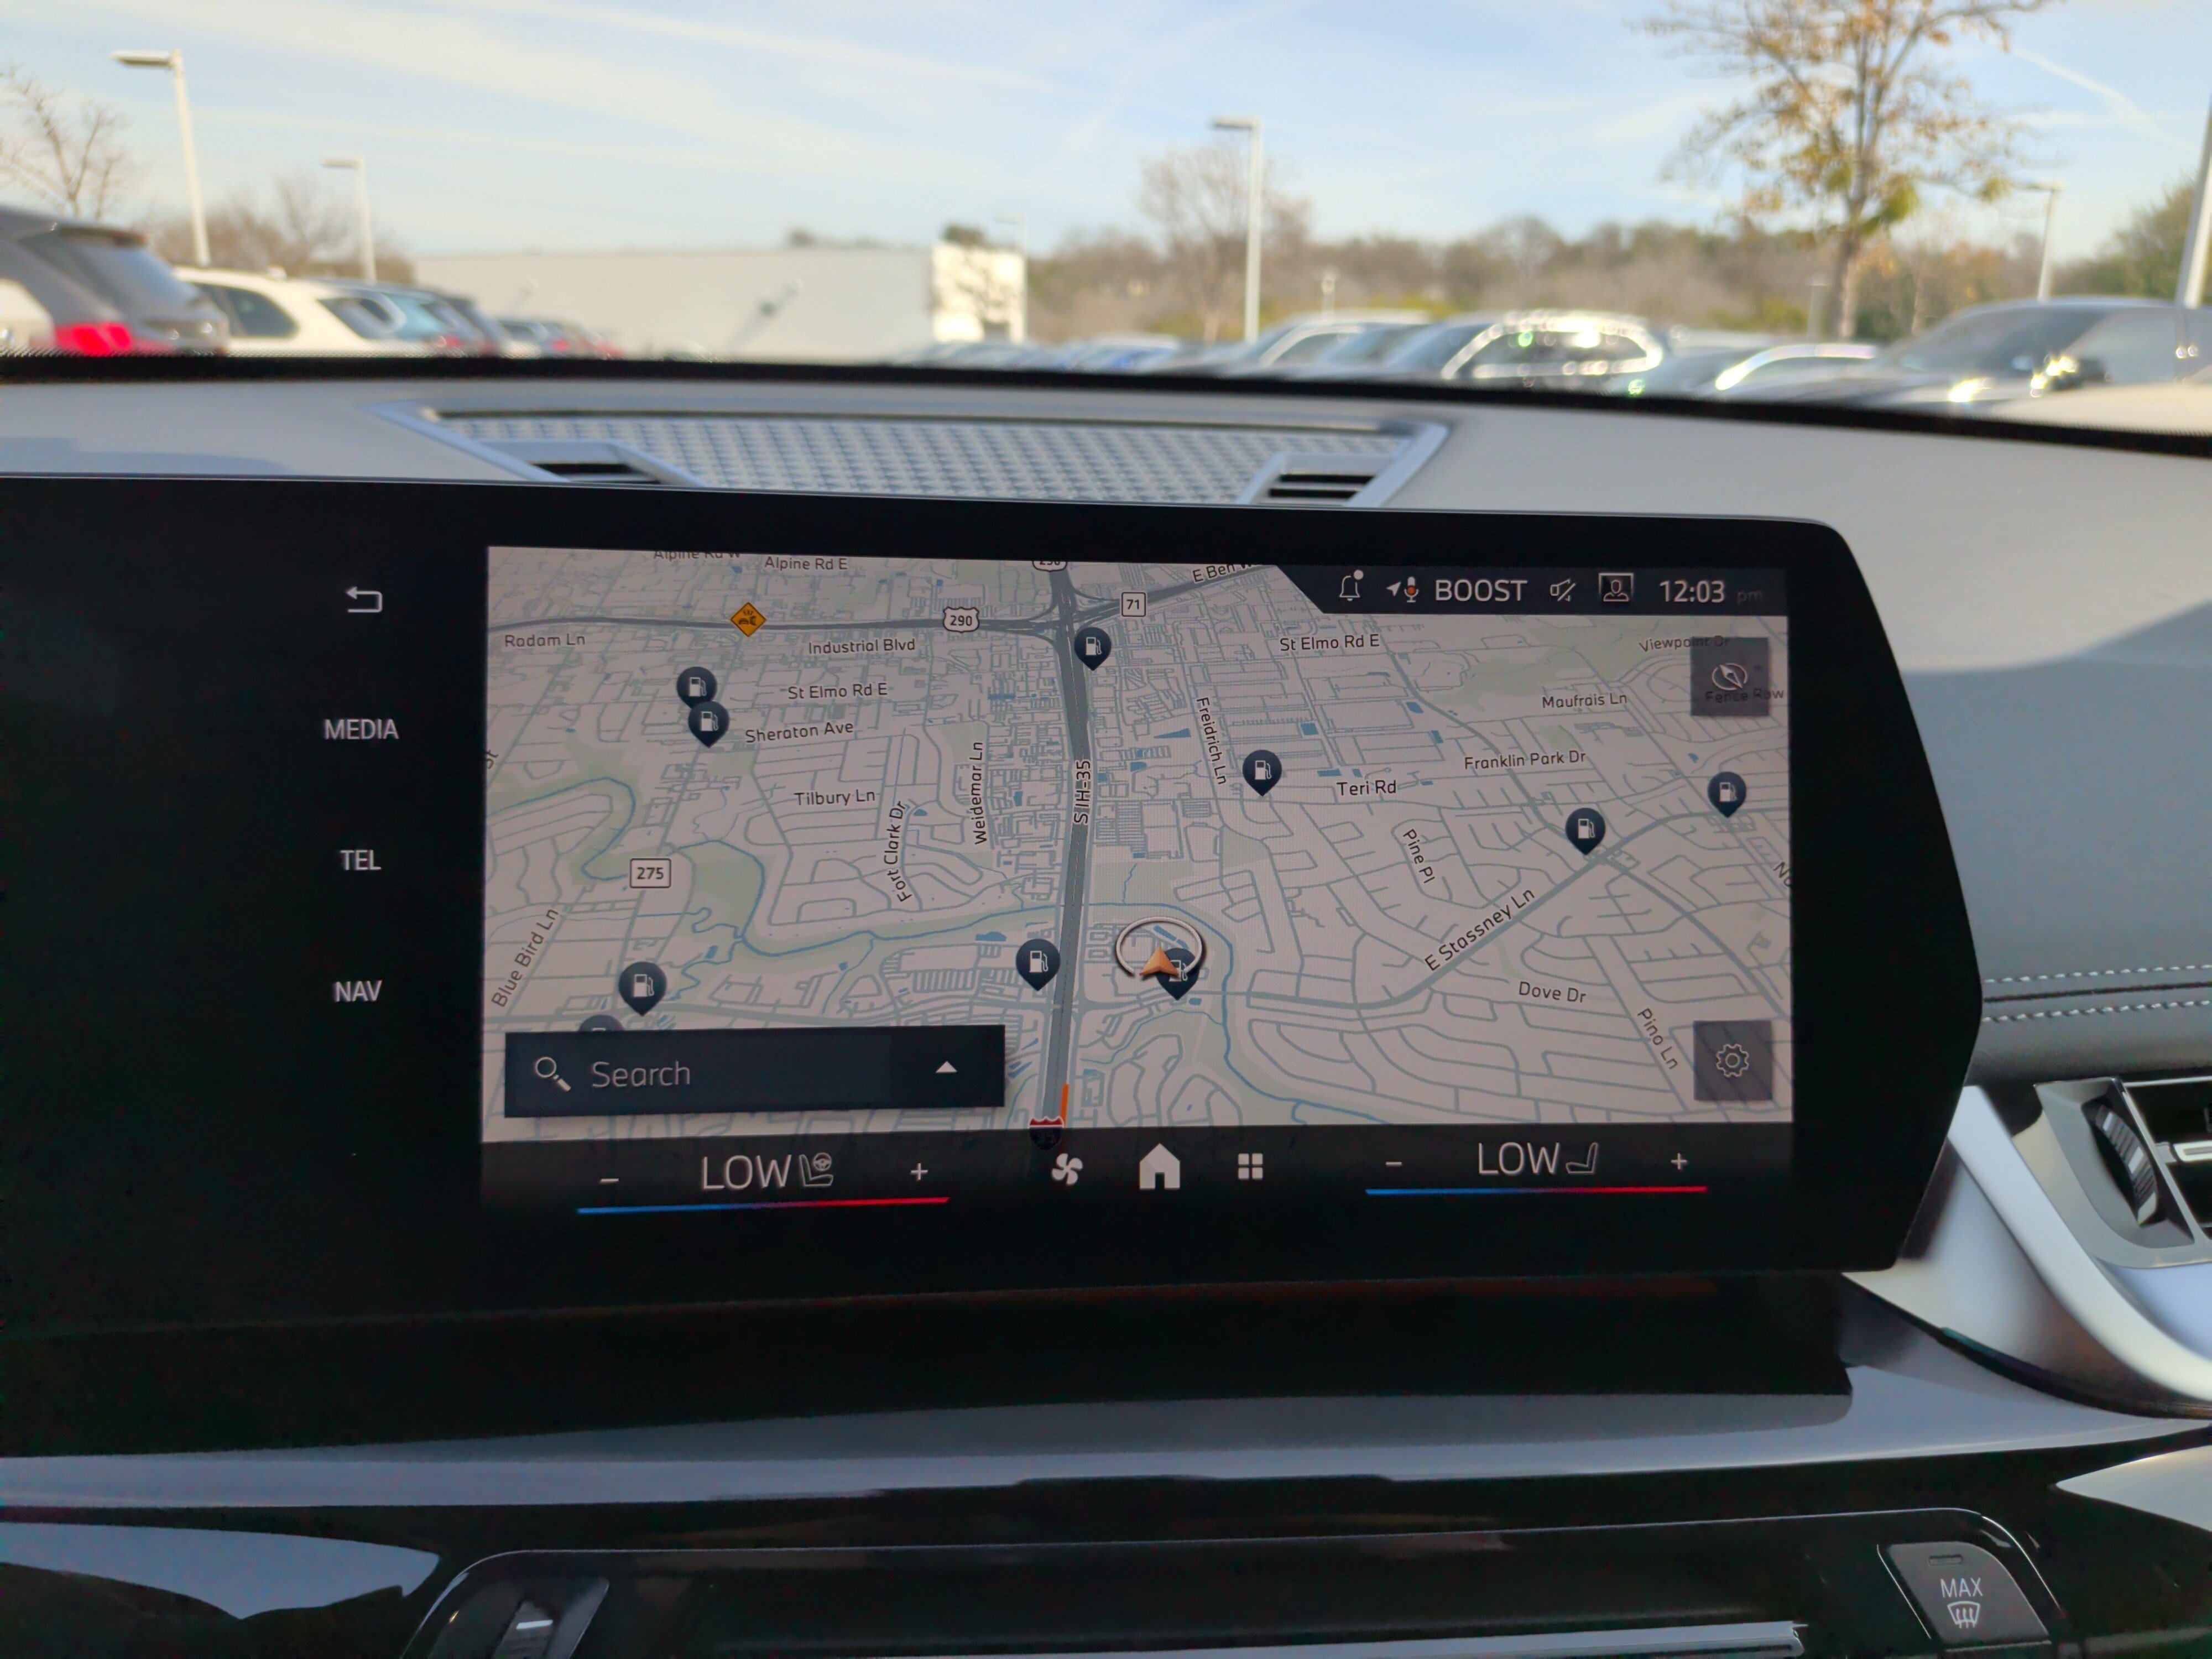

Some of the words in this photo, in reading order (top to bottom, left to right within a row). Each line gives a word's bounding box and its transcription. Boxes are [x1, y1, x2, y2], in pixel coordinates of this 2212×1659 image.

[765, 556, 810, 570] Alpine
[815, 558, 834, 570] Rd
[839, 558, 848, 570] E
[1192, 569, 1204, 582] E
[1435, 580, 1528, 602] BOOST
[1660, 580, 1725, 603] 12:03
[1126, 599, 1141, 610] 71
[950, 614, 972, 627] 290
[504, 634, 560, 648] Radam
[567, 634, 585, 646] Ln
[808, 640, 879, 654] Industrial
[884, 639, 915, 651] Blvd
[1280, 638, 1297, 651] St
[1301, 637, 1339, 650] Elmo
[1344, 634, 1364, 648] Rd
[1370, 634, 1380, 646] E
[1639, 638, 1709, 653] Viewpoint
[788, 687, 804, 700] St
[810, 686, 847, 699] Elmo
[853, 684, 873, 697] Rd
[878, 682, 888, 695] E
[1542, 695, 1605, 708] Maufrais
[1610, 692, 1627, 705] Ln
[324, 719, 399, 739] MEDIA
[745, 727, 818, 743] Sheraton
[824, 722, 854, 734] Ave
[969, 742, 983, 761] Ln
[1196, 697, 1221, 765] Freidrich
[1215, 766, 1227, 785] Ln
[1464, 756, 1525, 769] Franklin
[1530, 752, 1564, 768] Park
[1568, 750, 1585, 764] Dr
[1074, 760, 1091, 808] IH-35
[1336, 781, 1369, 796] Teri
[1375, 780, 1396, 794] Rd
[794, 792, 850, 806] Tilbury
[856, 789, 875, 802] Ln
[969, 765, 987, 845] Weidemar
[889, 801, 905, 820] Dr
[1074, 812, 1088, 824] S
[884, 824, 901, 864] Clark
[1403, 828, 1425, 864] Pine
[340, 849, 381, 870] TEL
[637, 867, 664, 879] 275
[886, 869, 912, 902] Fort
[1423, 955, 1439, 971] E
[1439, 902, 1512, 960] Stassney
[1510, 887, 1535, 909] Ln
[491, 969, 521, 1007] Blue
[516, 933, 544, 967] Bird
[540, 908, 559, 932] Ln
[334, 981, 382, 1002] NAV
[1519, 981, 1562, 1001] Dove
[1567, 988, 1587, 1003] Dr
[1658, 1047, 1679, 1070] Ln
[592, 1061, 691, 1088] Search
[1478, 1142, 1559, 1175] LOW
[702, 1154, 792, 1190] LOW
[1940, 1577, 1983, 1598] MAX
